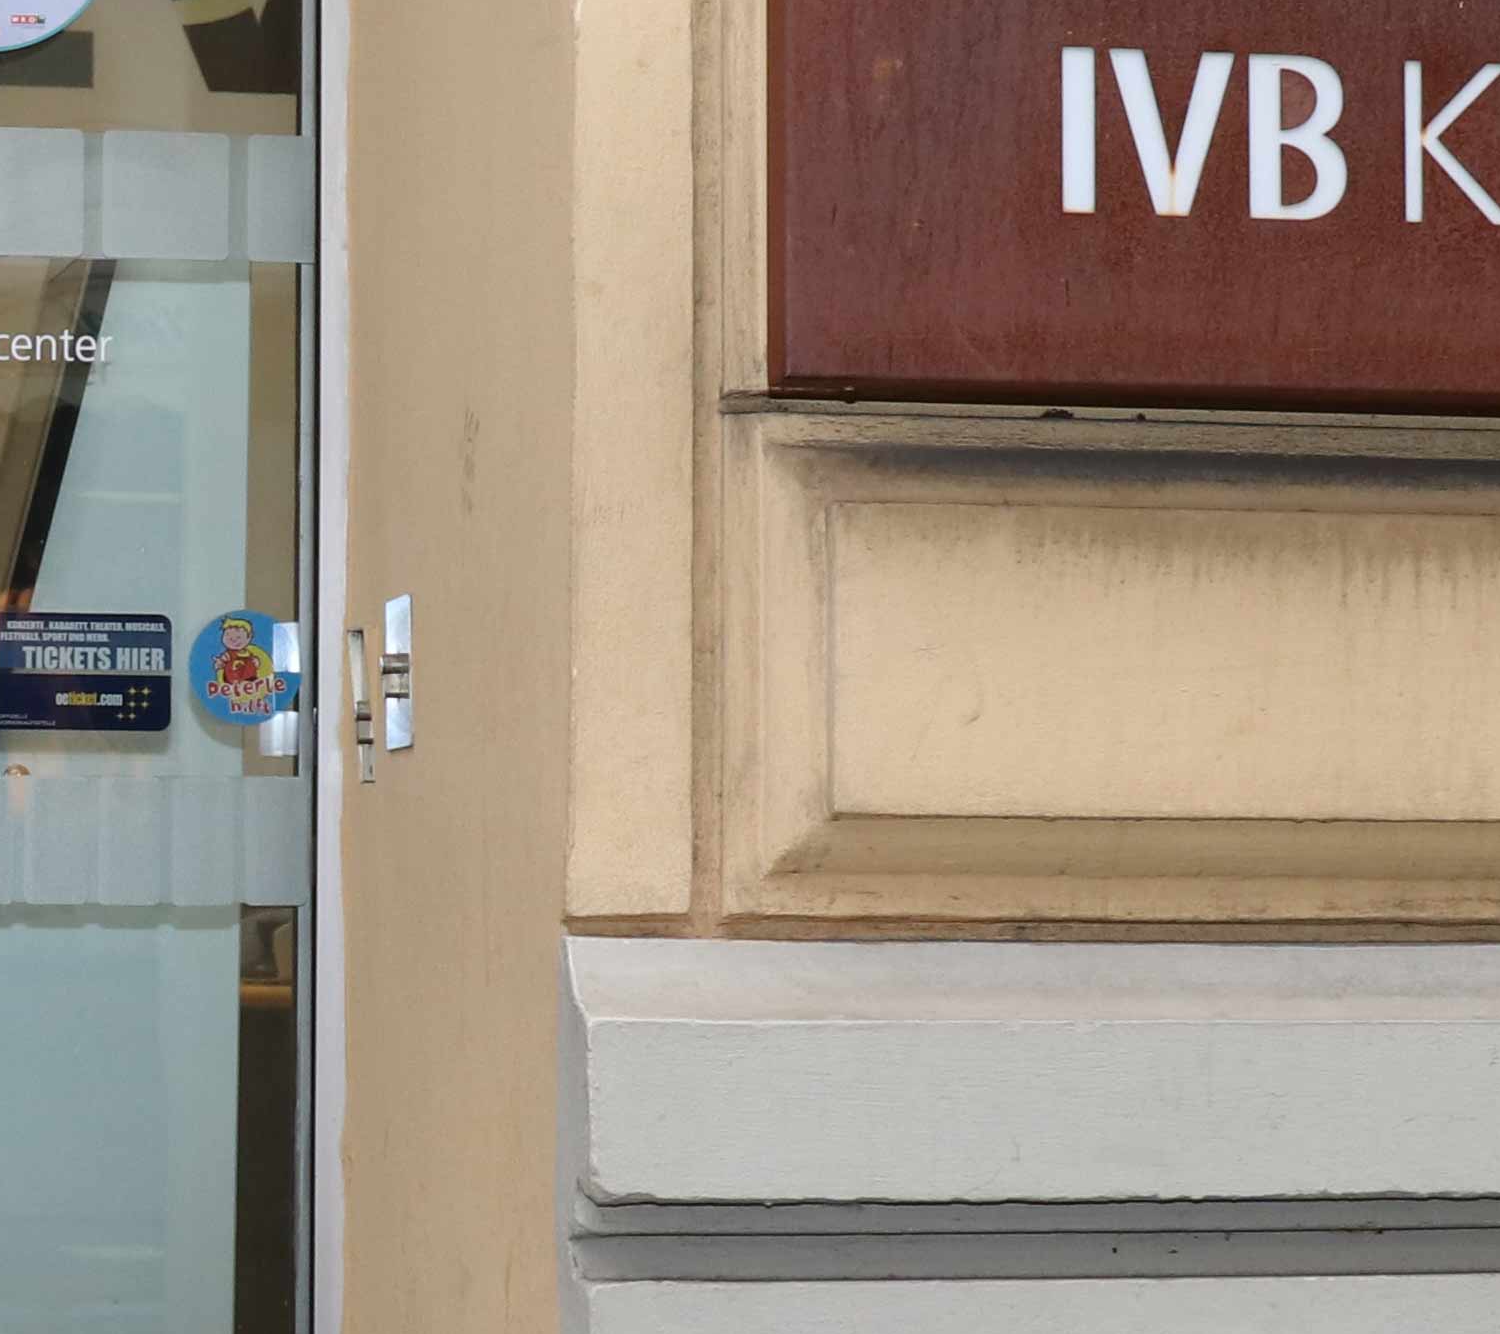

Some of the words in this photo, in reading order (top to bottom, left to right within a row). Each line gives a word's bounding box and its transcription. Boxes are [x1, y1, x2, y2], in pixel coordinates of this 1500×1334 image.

[1061, 47, 1347, 220] IVB
[22, 645, 112, 670] TICKETS
[116, 647, 166, 672] HIER
[55, 689, 123, 707] oeticket.com
[207, 676, 287, 699] Peterle
